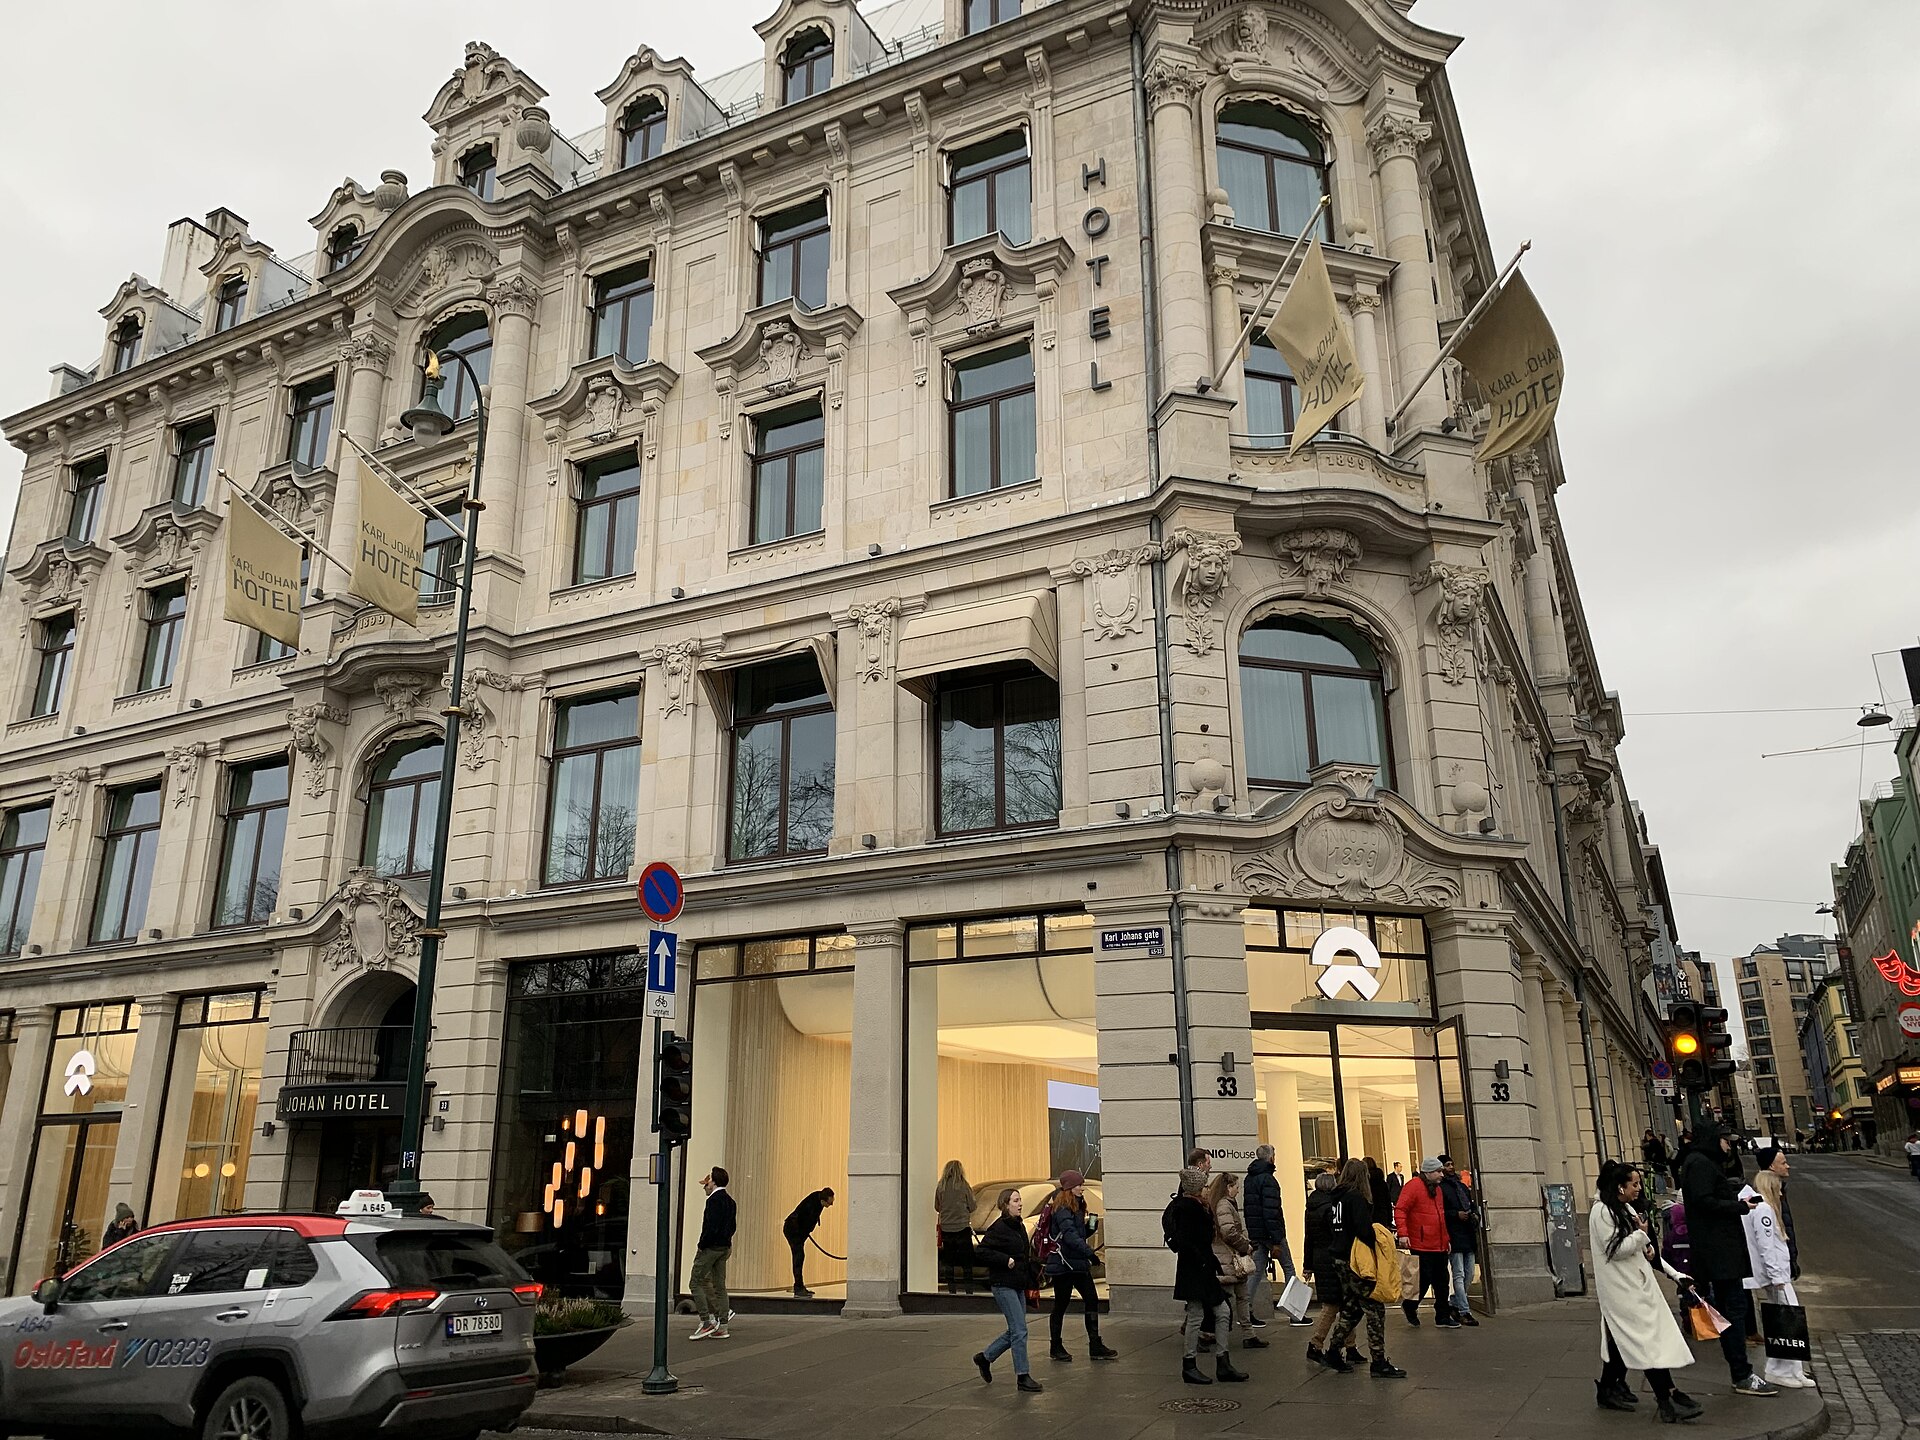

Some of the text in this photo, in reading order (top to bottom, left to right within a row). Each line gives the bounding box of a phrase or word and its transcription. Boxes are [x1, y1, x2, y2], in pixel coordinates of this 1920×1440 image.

[1082, 157, 1112, 391] HOTEL
[1302, 349, 1352, 414] HOTEL
[1488, 370, 1522, 397] KARL
[1326, 454, 1366, 470] 1899
[362, 520, 421, 563] KARL JOHAN
[230, 554, 298, 591] KARL JOHAN
[362, 540, 420, 591] HOTEL
[233, 569, 300, 615] HOTEL
[1104, 929, 1160, 942] Karl Johans gate
[1217, 1076, 1238, 1097] 33
[1490, 1082, 1510, 1102] 33
[286, 1095, 326, 1112] JOHAN
[333, 1094, 390, 1110] HOTEL
[362, 1203, 386, 1213] A 645
[171, 1273, 193, 1284] Taxi
[16, 1317, 53, 1333] A645
[455, 1315, 500, 1331] DR 78580
[145, 1337, 212, 1368] 02323
[1767, 1337, 1806, 1348] TATLER
[14, 1339, 120, 1369] OsloTaxi
